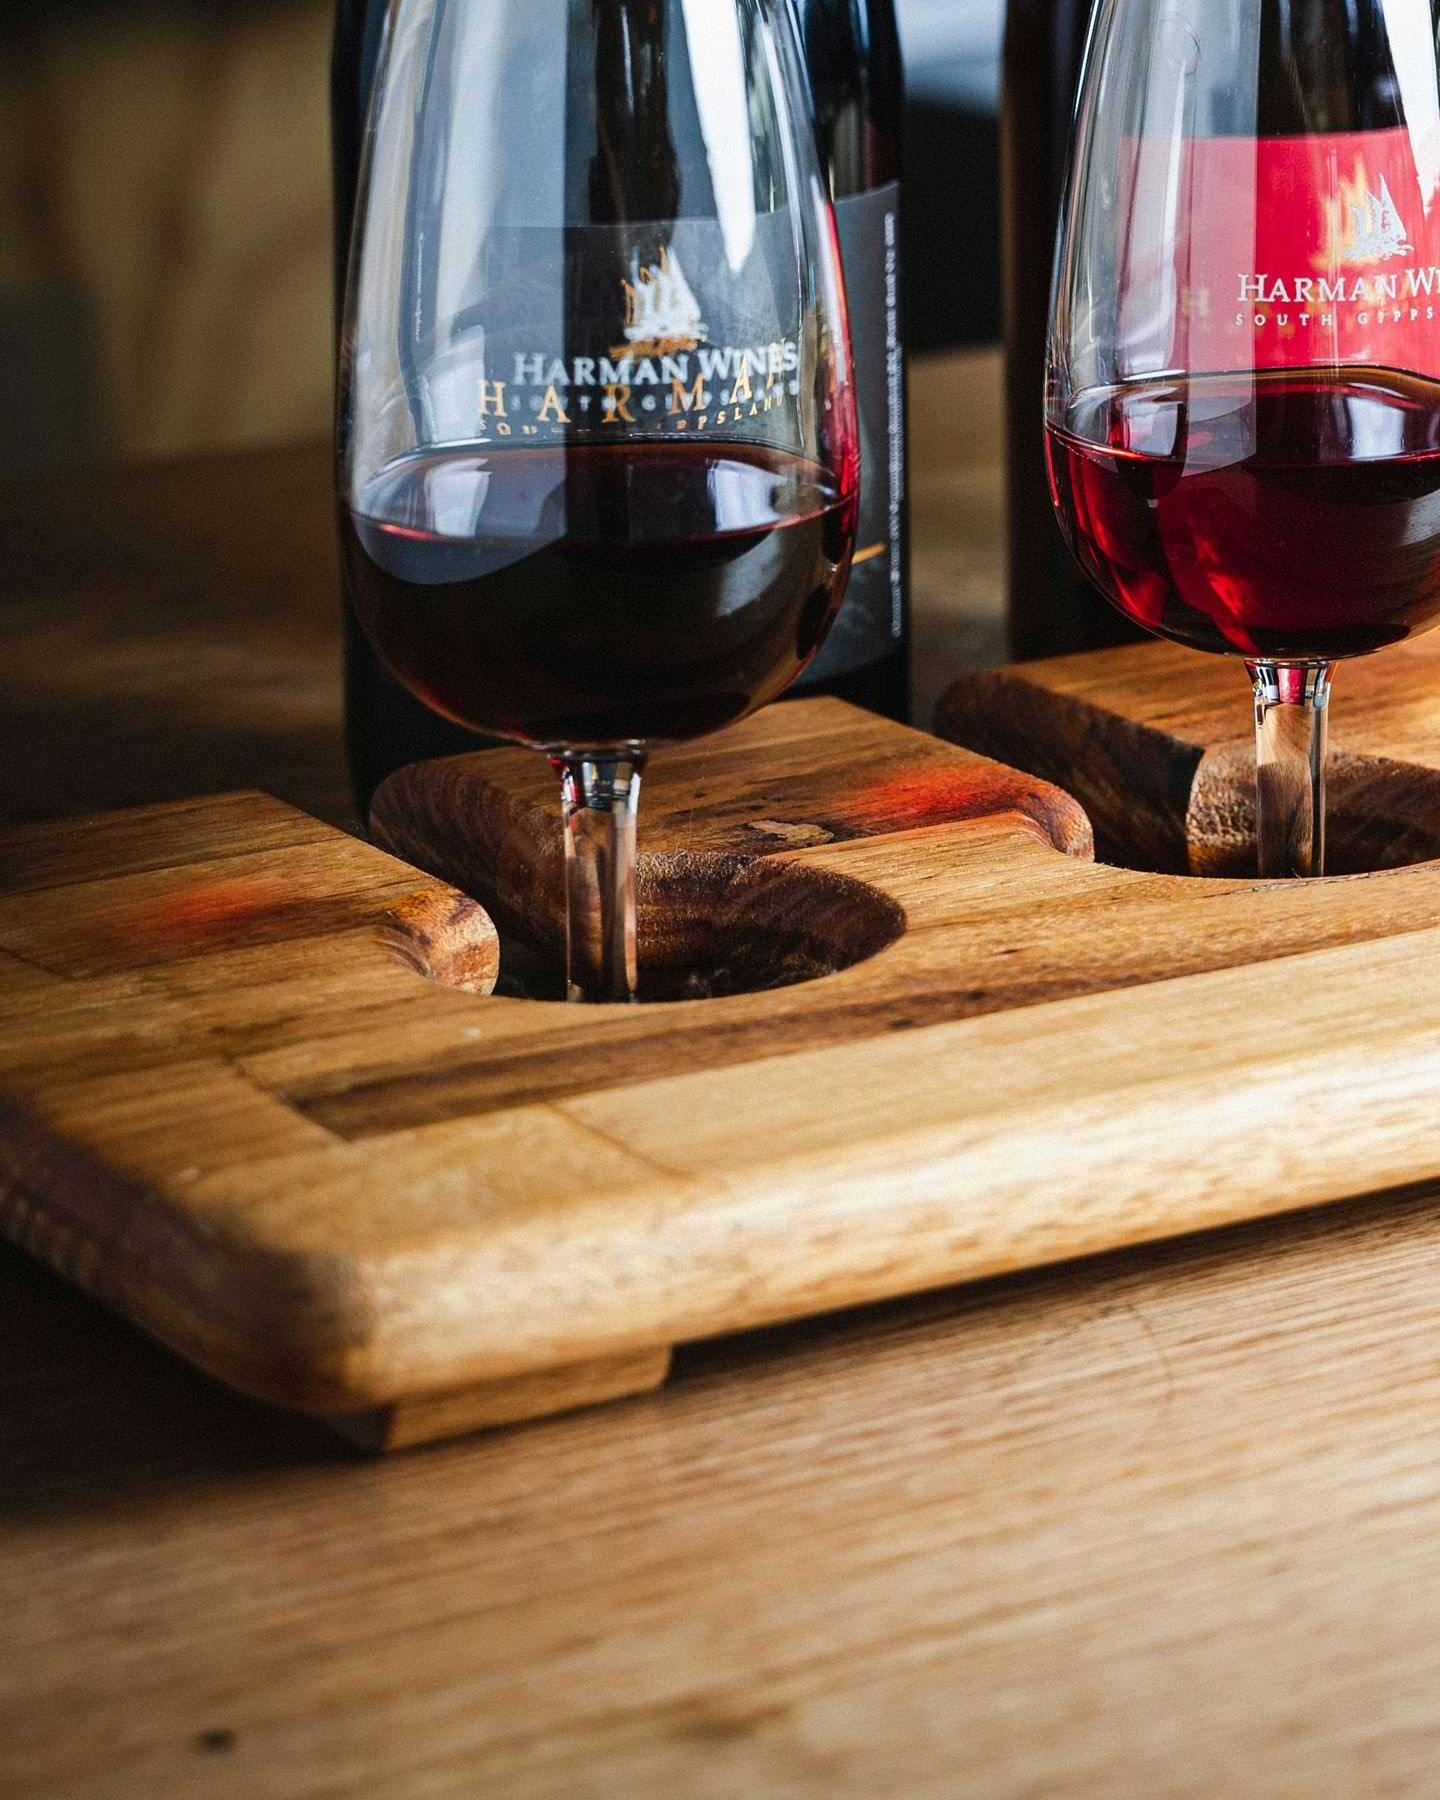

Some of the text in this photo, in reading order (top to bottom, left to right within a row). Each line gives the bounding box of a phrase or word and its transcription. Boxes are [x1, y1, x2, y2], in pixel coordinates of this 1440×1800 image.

[1236, 272, 1398, 303] HARMAN
[1235, 312, 1333, 327] SOUTH
[512, 340, 798, 386] HARMAN WINES
